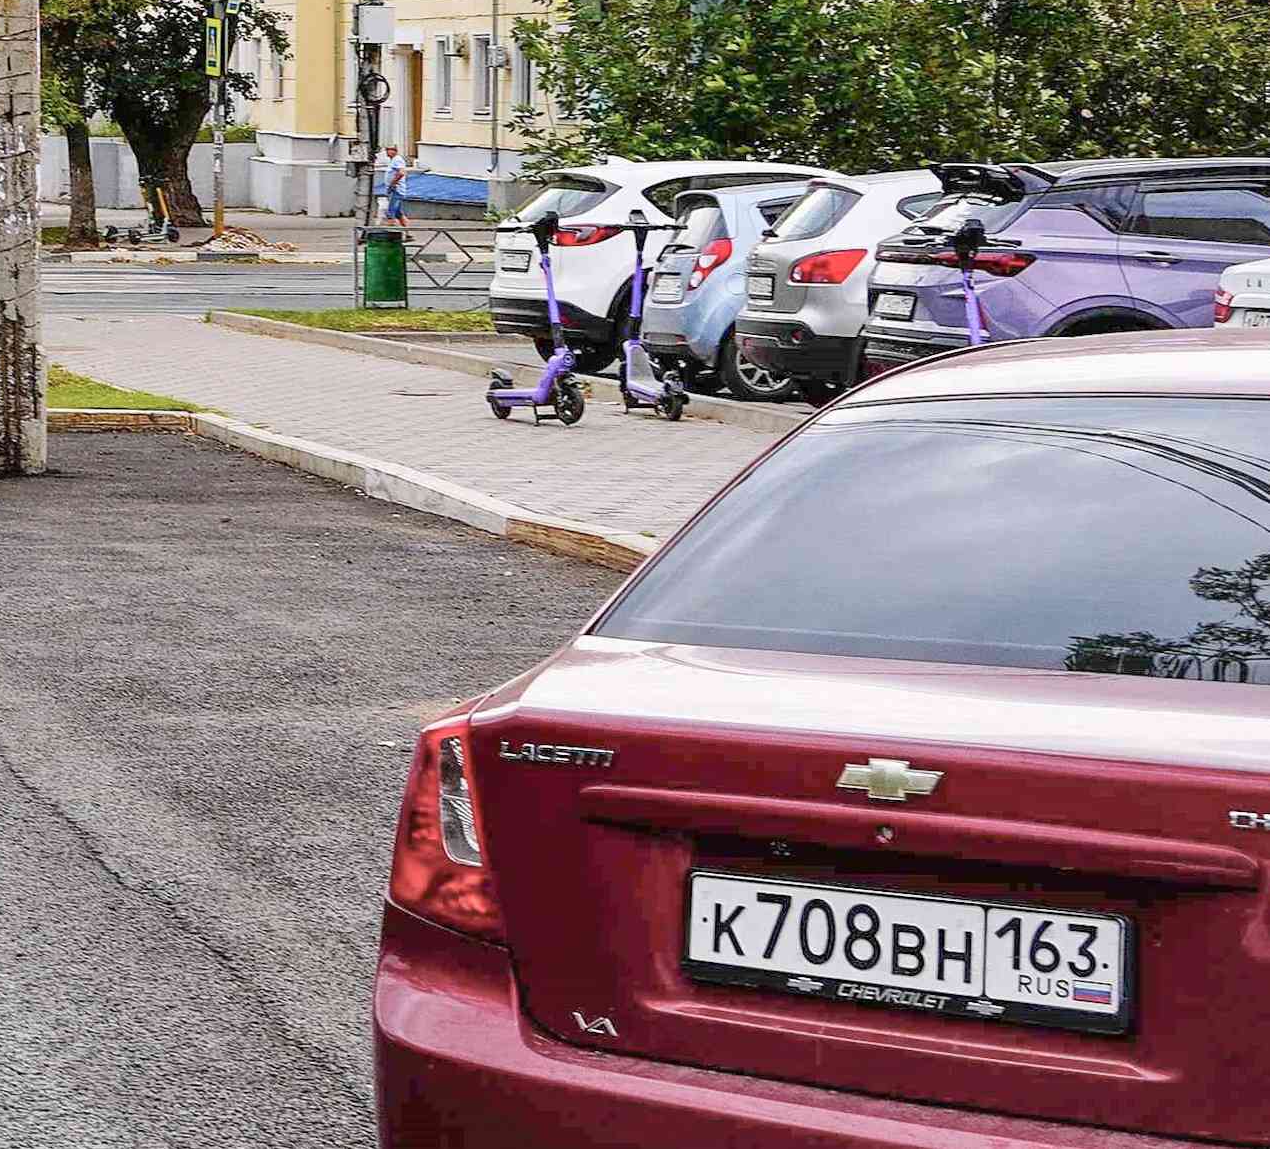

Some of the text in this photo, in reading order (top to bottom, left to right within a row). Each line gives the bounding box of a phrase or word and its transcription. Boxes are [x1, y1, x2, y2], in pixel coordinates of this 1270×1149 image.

[500, 740, 615, 768] LACETTI
[995, 916, 1099, 978] 163
[836, 983, 951, 1011] CHEVROLET
[1018, 974, 1069, 999] RUS
